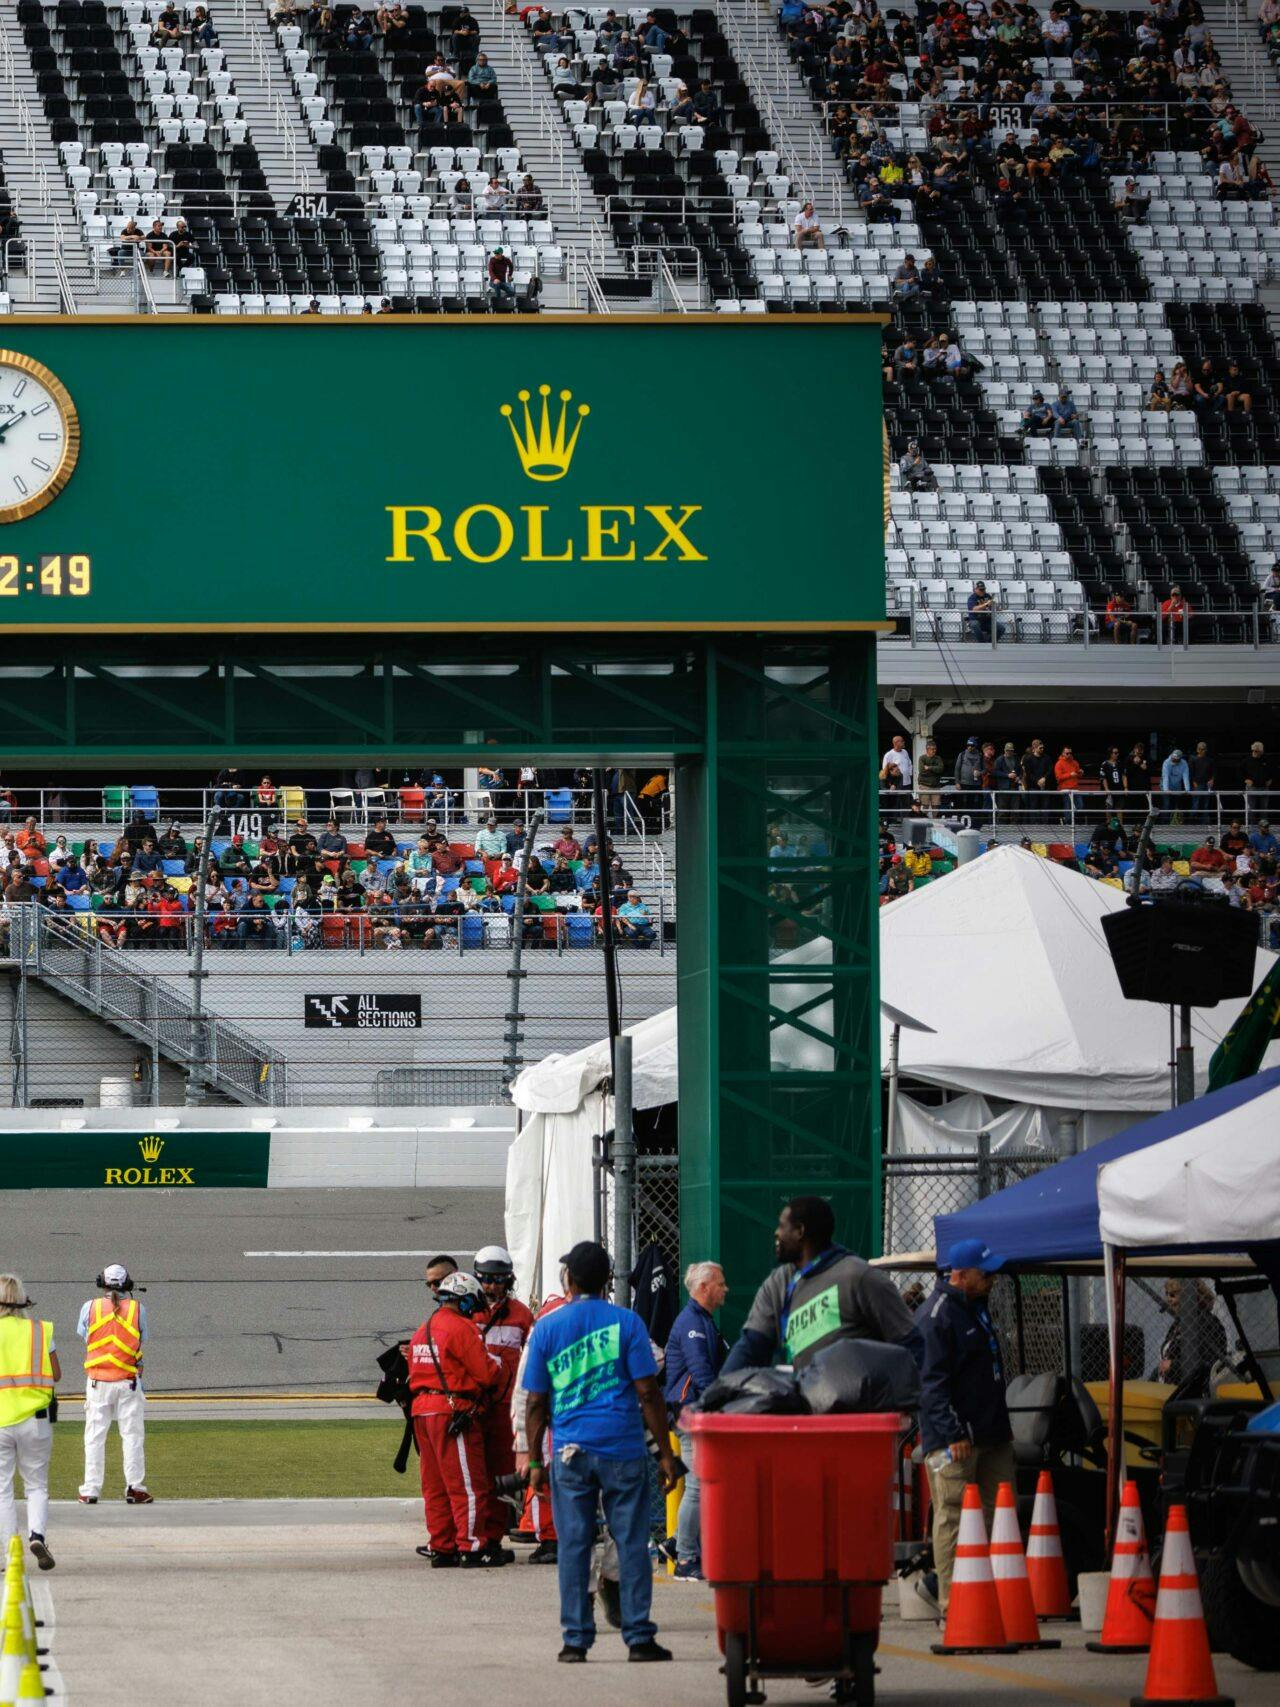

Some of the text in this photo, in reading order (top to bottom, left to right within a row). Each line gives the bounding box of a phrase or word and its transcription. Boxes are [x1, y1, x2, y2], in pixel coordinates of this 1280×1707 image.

[990, 107, 1022, 129] 353
[294, 195, 329, 218] 354
[385, 503, 709, 564] ROLEX
[228, 813, 262, 841] 149
[358, 995, 379, 1011] ALL
[358, 1011, 417, 1027] SECTIONS
[104, 1168, 196, 1185] ROLEX
[786, 1294, 830, 1342] RICK'S
